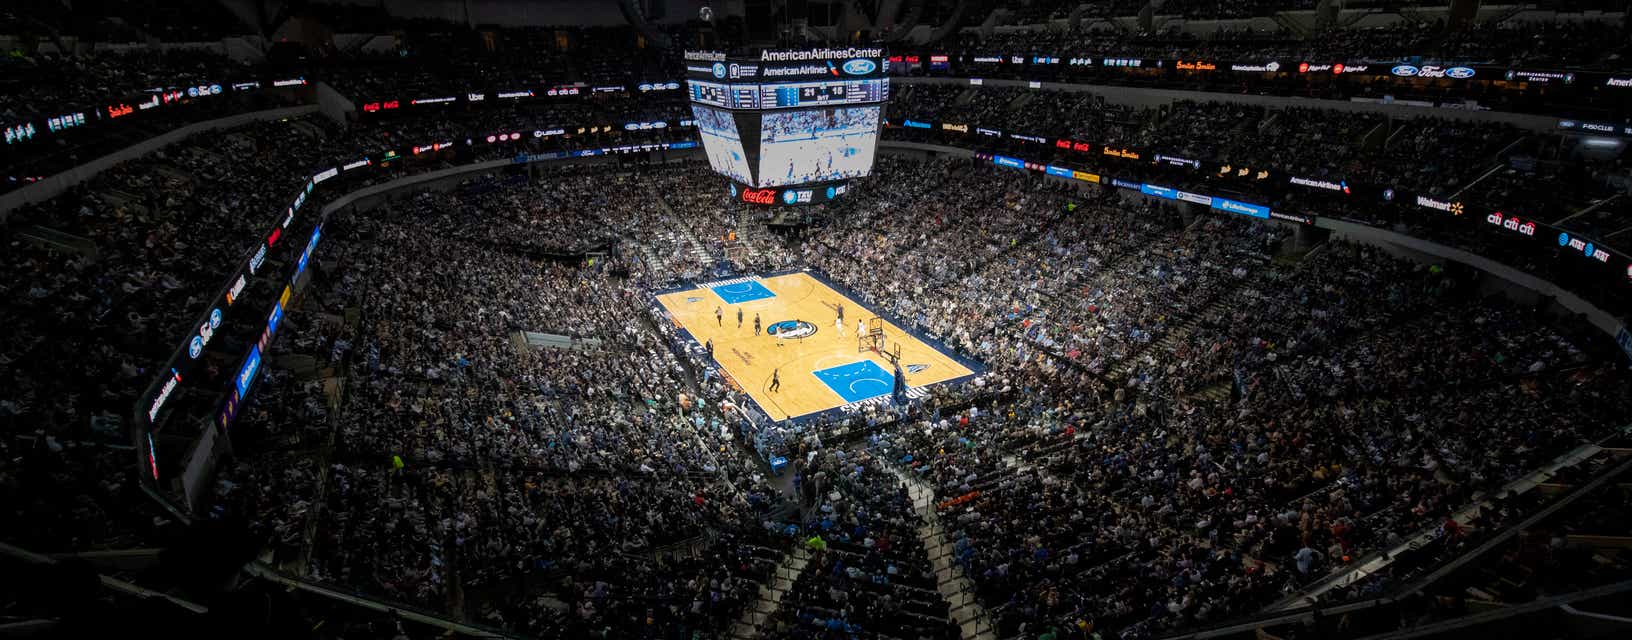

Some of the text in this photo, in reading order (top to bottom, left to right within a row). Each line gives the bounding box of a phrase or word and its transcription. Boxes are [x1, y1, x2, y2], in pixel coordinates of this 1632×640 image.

[1418, 65, 1446, 77] Ford
[1290, 176, 1341, 190] American Airlines
[1417, 195, 1452, 212] Walmart
[1487, 212, 1536, 236] citi citi citi
